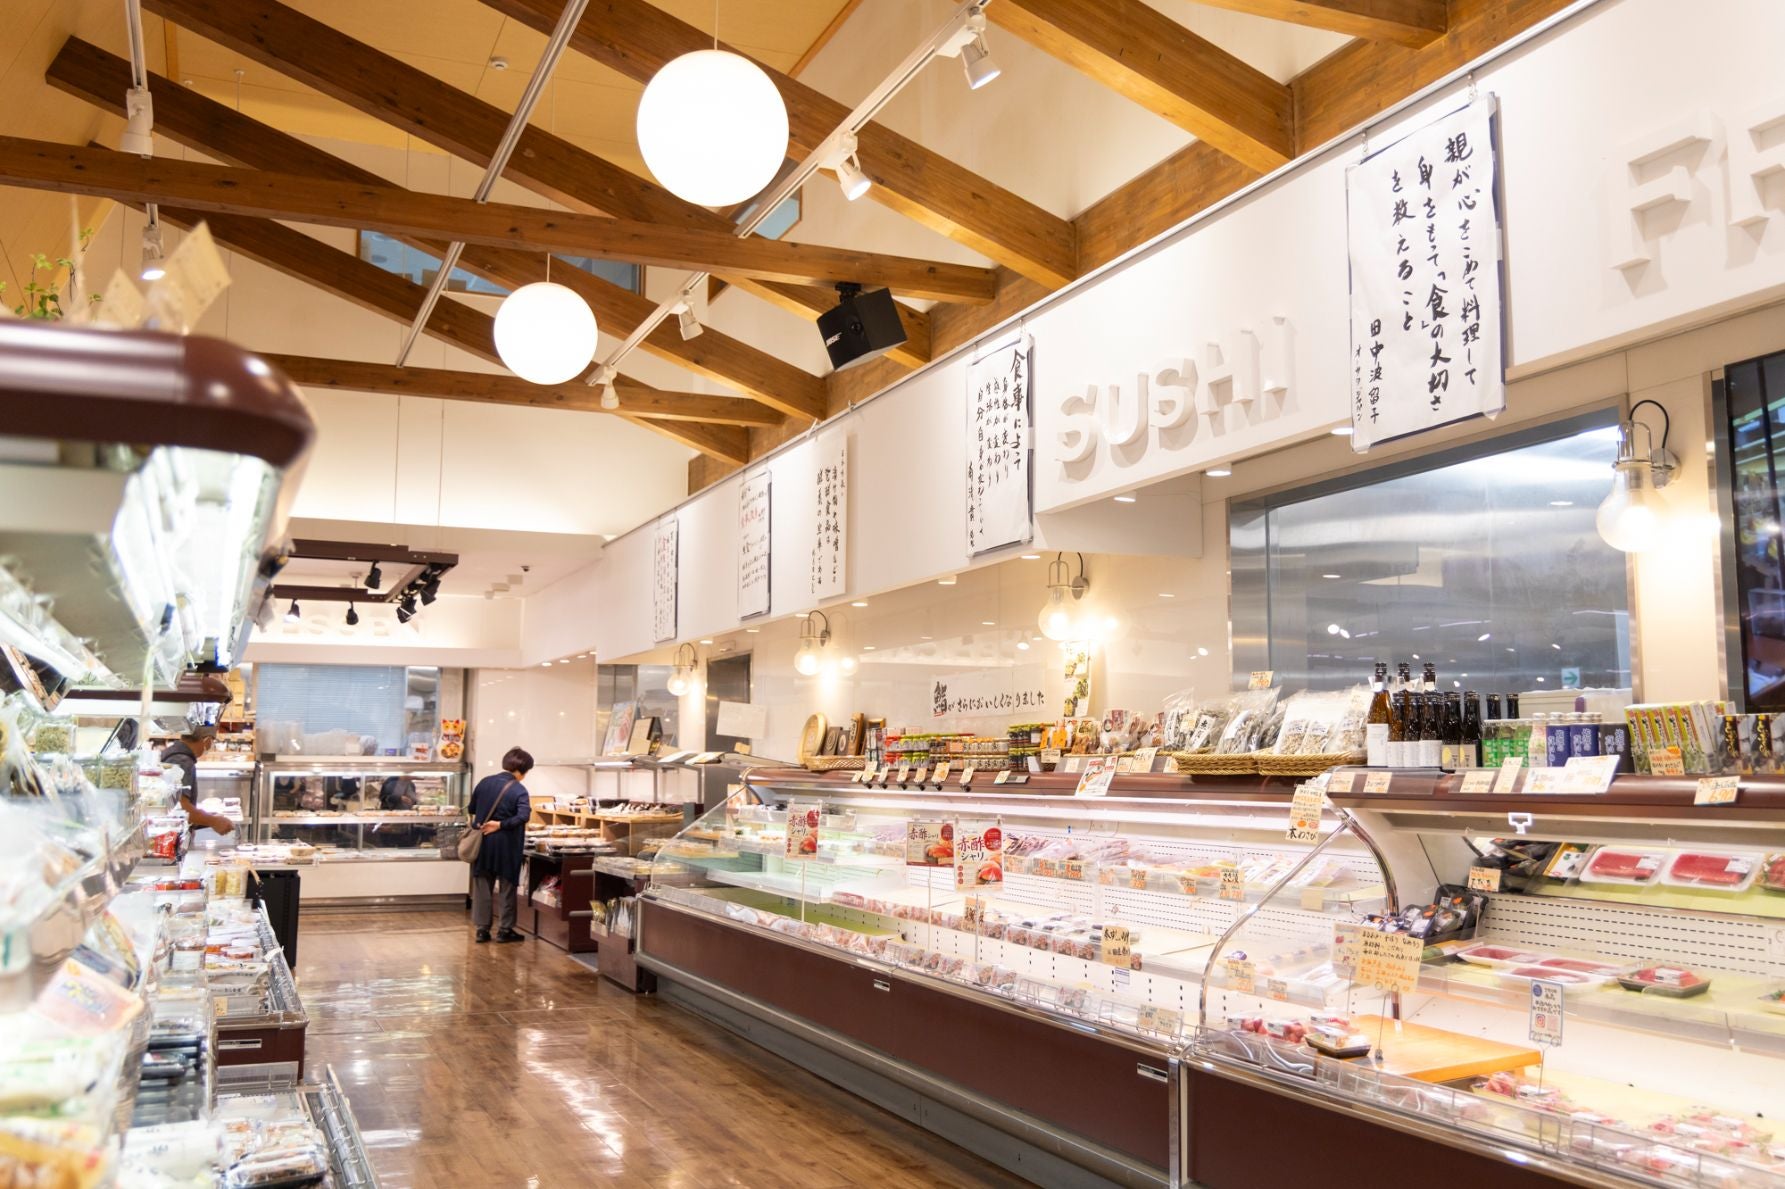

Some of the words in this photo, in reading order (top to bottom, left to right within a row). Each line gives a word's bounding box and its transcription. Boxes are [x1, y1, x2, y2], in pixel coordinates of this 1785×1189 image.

[1054, 313, 1295, 466] SUSHI
[956, 835, 985, 852] 赤酢
[961, 852, 985, 861] シャリ
